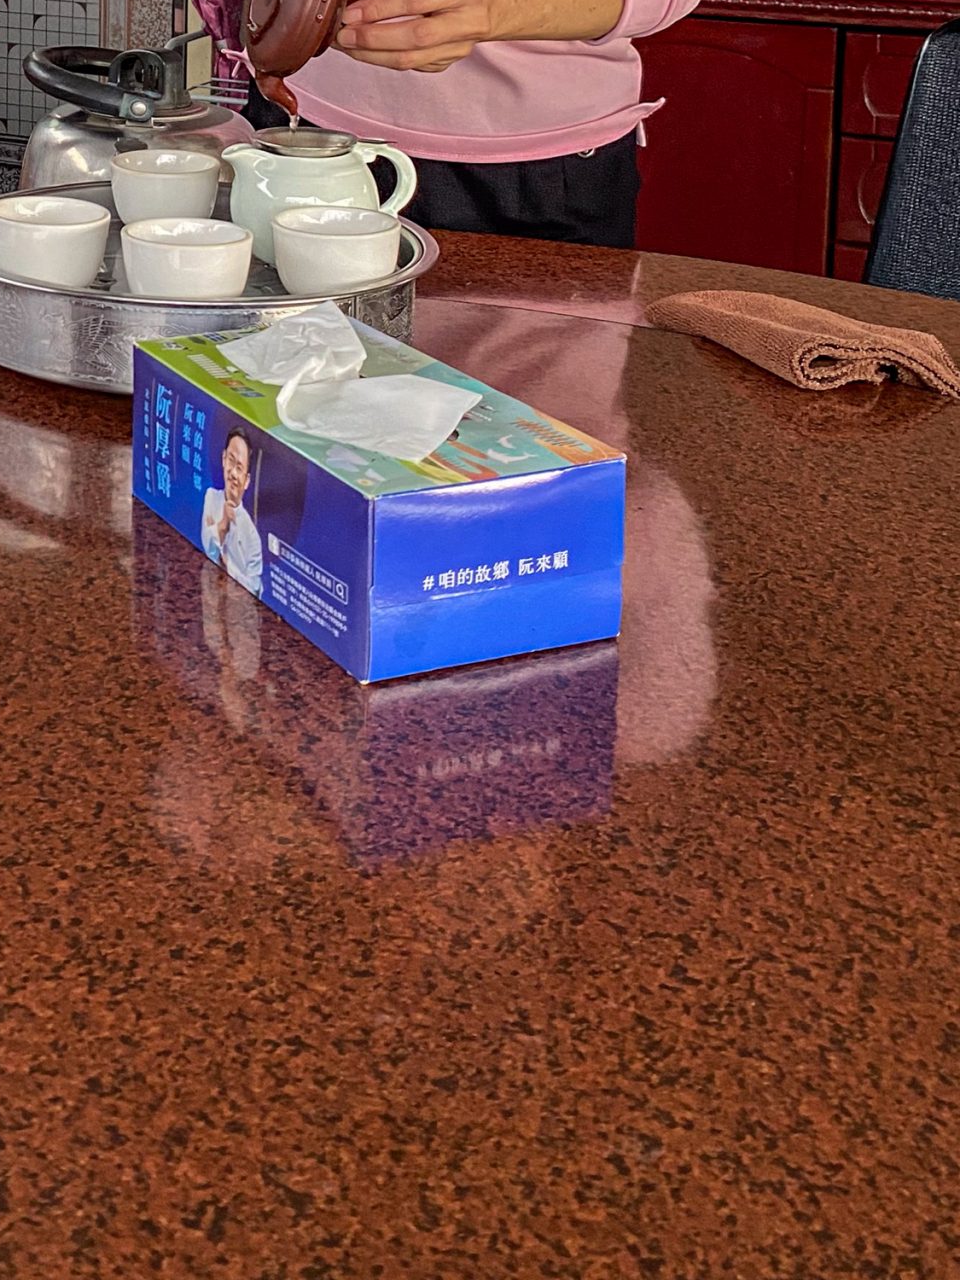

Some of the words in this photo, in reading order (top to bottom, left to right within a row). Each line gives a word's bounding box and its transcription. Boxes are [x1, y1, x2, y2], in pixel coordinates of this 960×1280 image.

[422, 560, 510, 591] #咱的故鄉
[518, 550, 569, 576] 阮來顧
